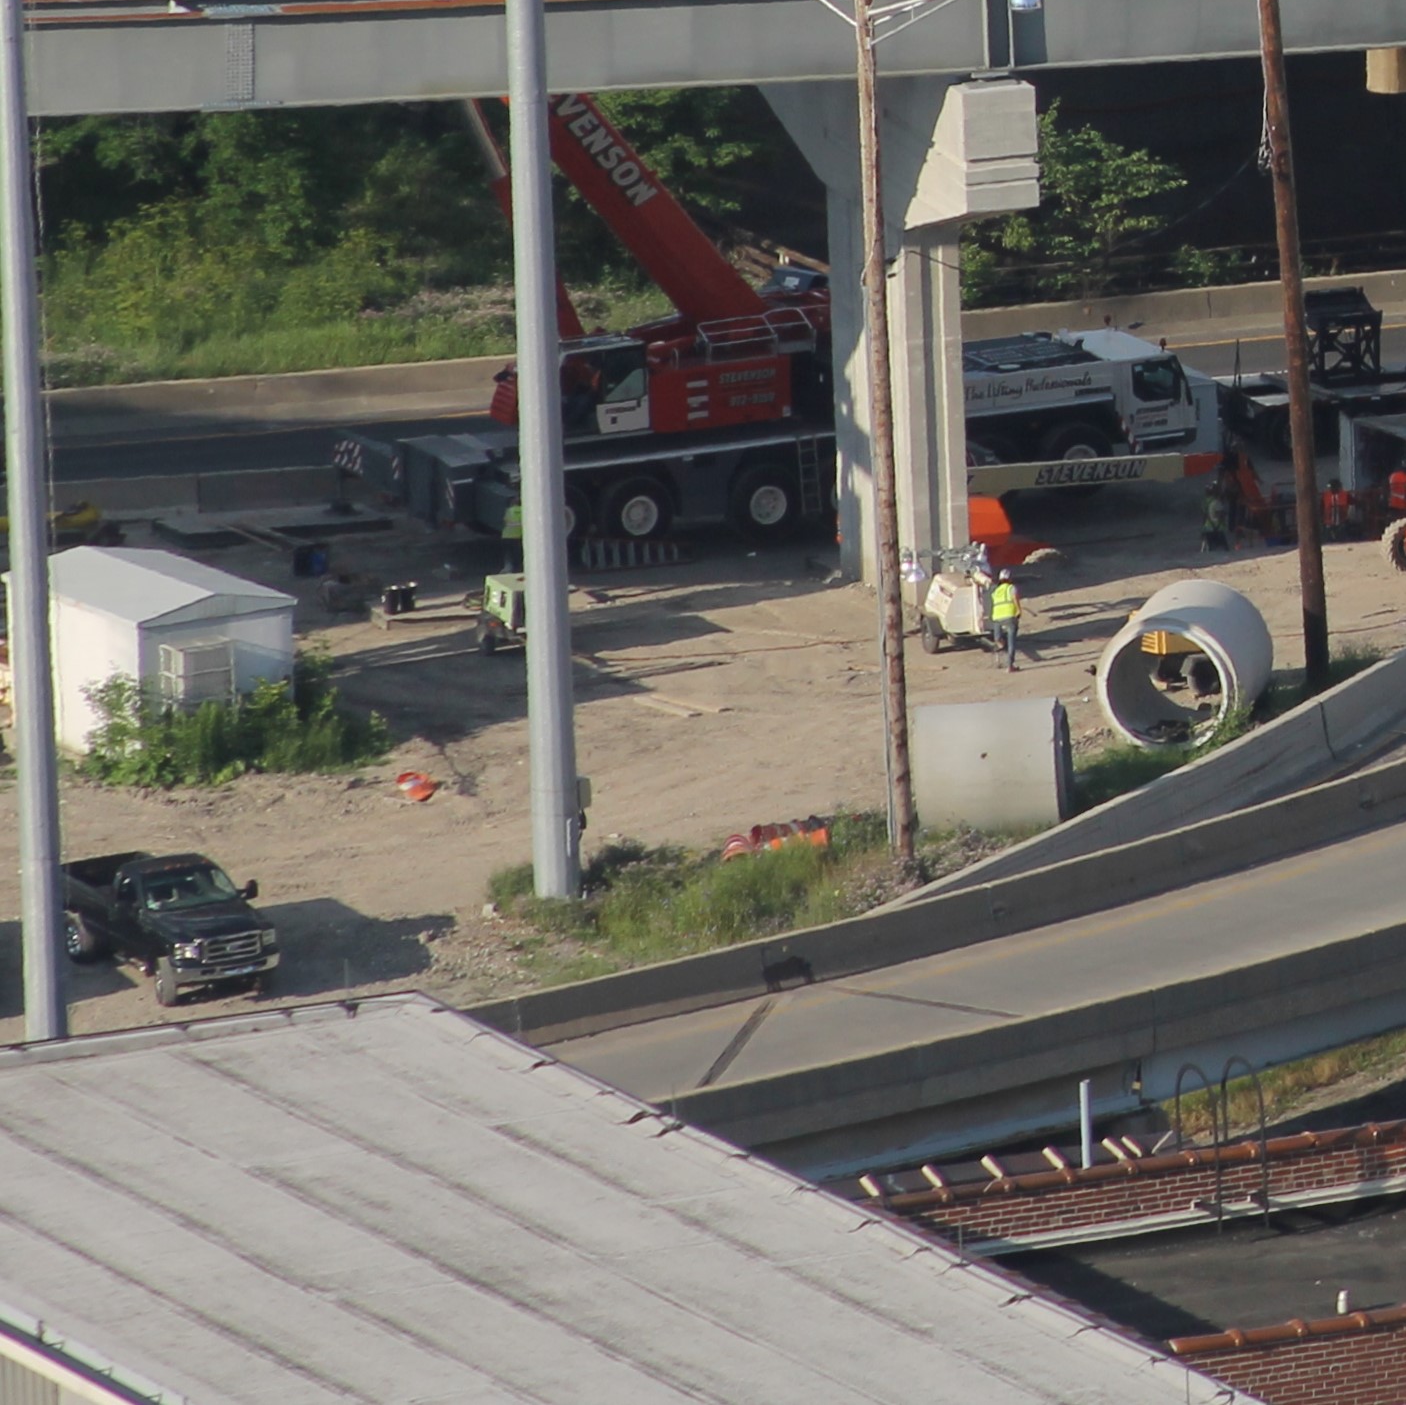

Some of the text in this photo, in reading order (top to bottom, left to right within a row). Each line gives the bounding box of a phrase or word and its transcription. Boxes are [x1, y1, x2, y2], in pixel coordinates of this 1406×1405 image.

[549, 93, 658, 207] VENSON
[719, 368, 776, 384] STEVENSON
[965, 387, 984, 402] The
[1035, 460, 1147, 485] STEVENSON
